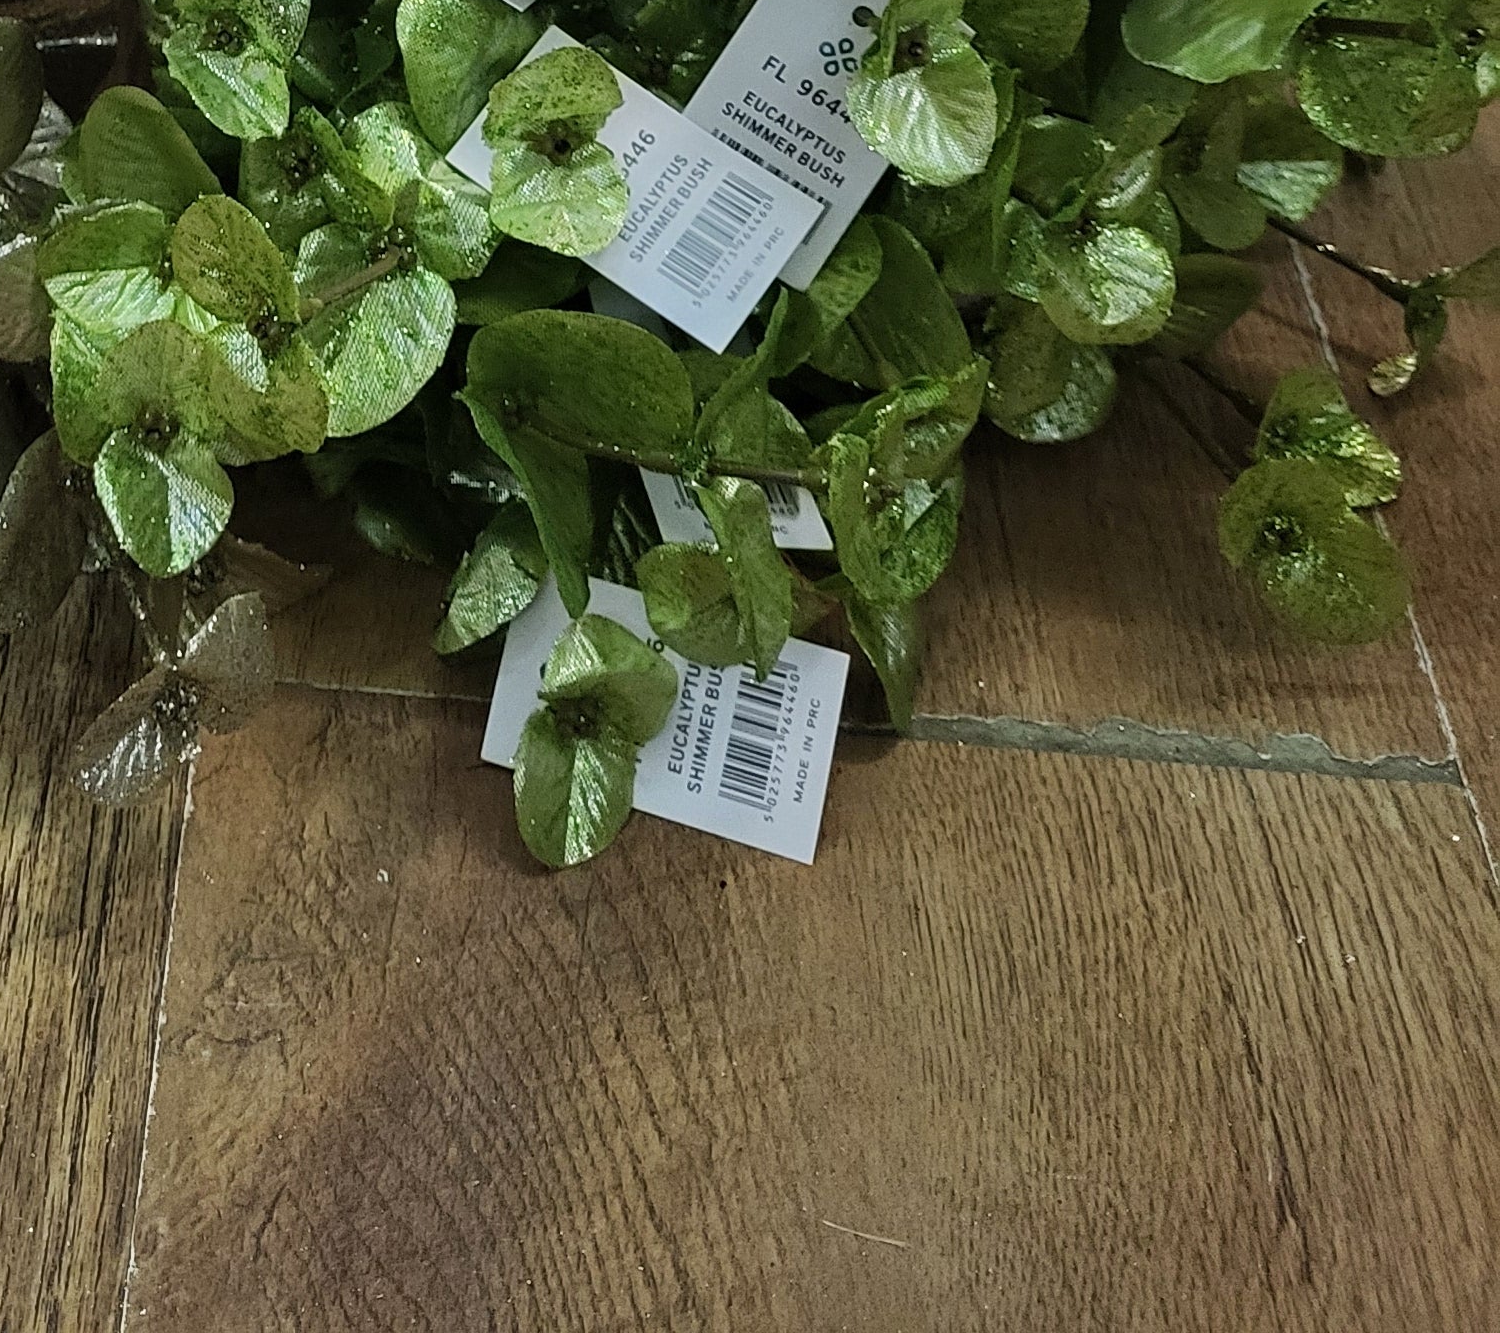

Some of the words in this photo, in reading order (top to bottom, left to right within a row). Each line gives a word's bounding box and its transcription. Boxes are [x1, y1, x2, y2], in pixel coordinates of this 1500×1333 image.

[742, 90, 847, 165] EUCALYPTUS
[761, 55, 787, 84] FL
[796, 79, 851, 124] 9644
[721, 101, 798, 159] SHIMMER
[797, 151, 846, 189] BUSH
[618, 154, 689, 244] EUCALYPTUS
[629, 196, 685, 264] SHIMMER
[676, 157, 714, 201] BUSH
[726, 269, 756, 304] MADE
[751, 252, 767, 268] IN
[763, 226, 786, 251] PRC
[667, 662, 702, 775] EUCALYPTU
[687, 703, 718, 795] SHIMMER
[801, 735, 815, 753] IN
[806, 697, 822, 729] PRC
[792, 758, 811, 804] MADE
